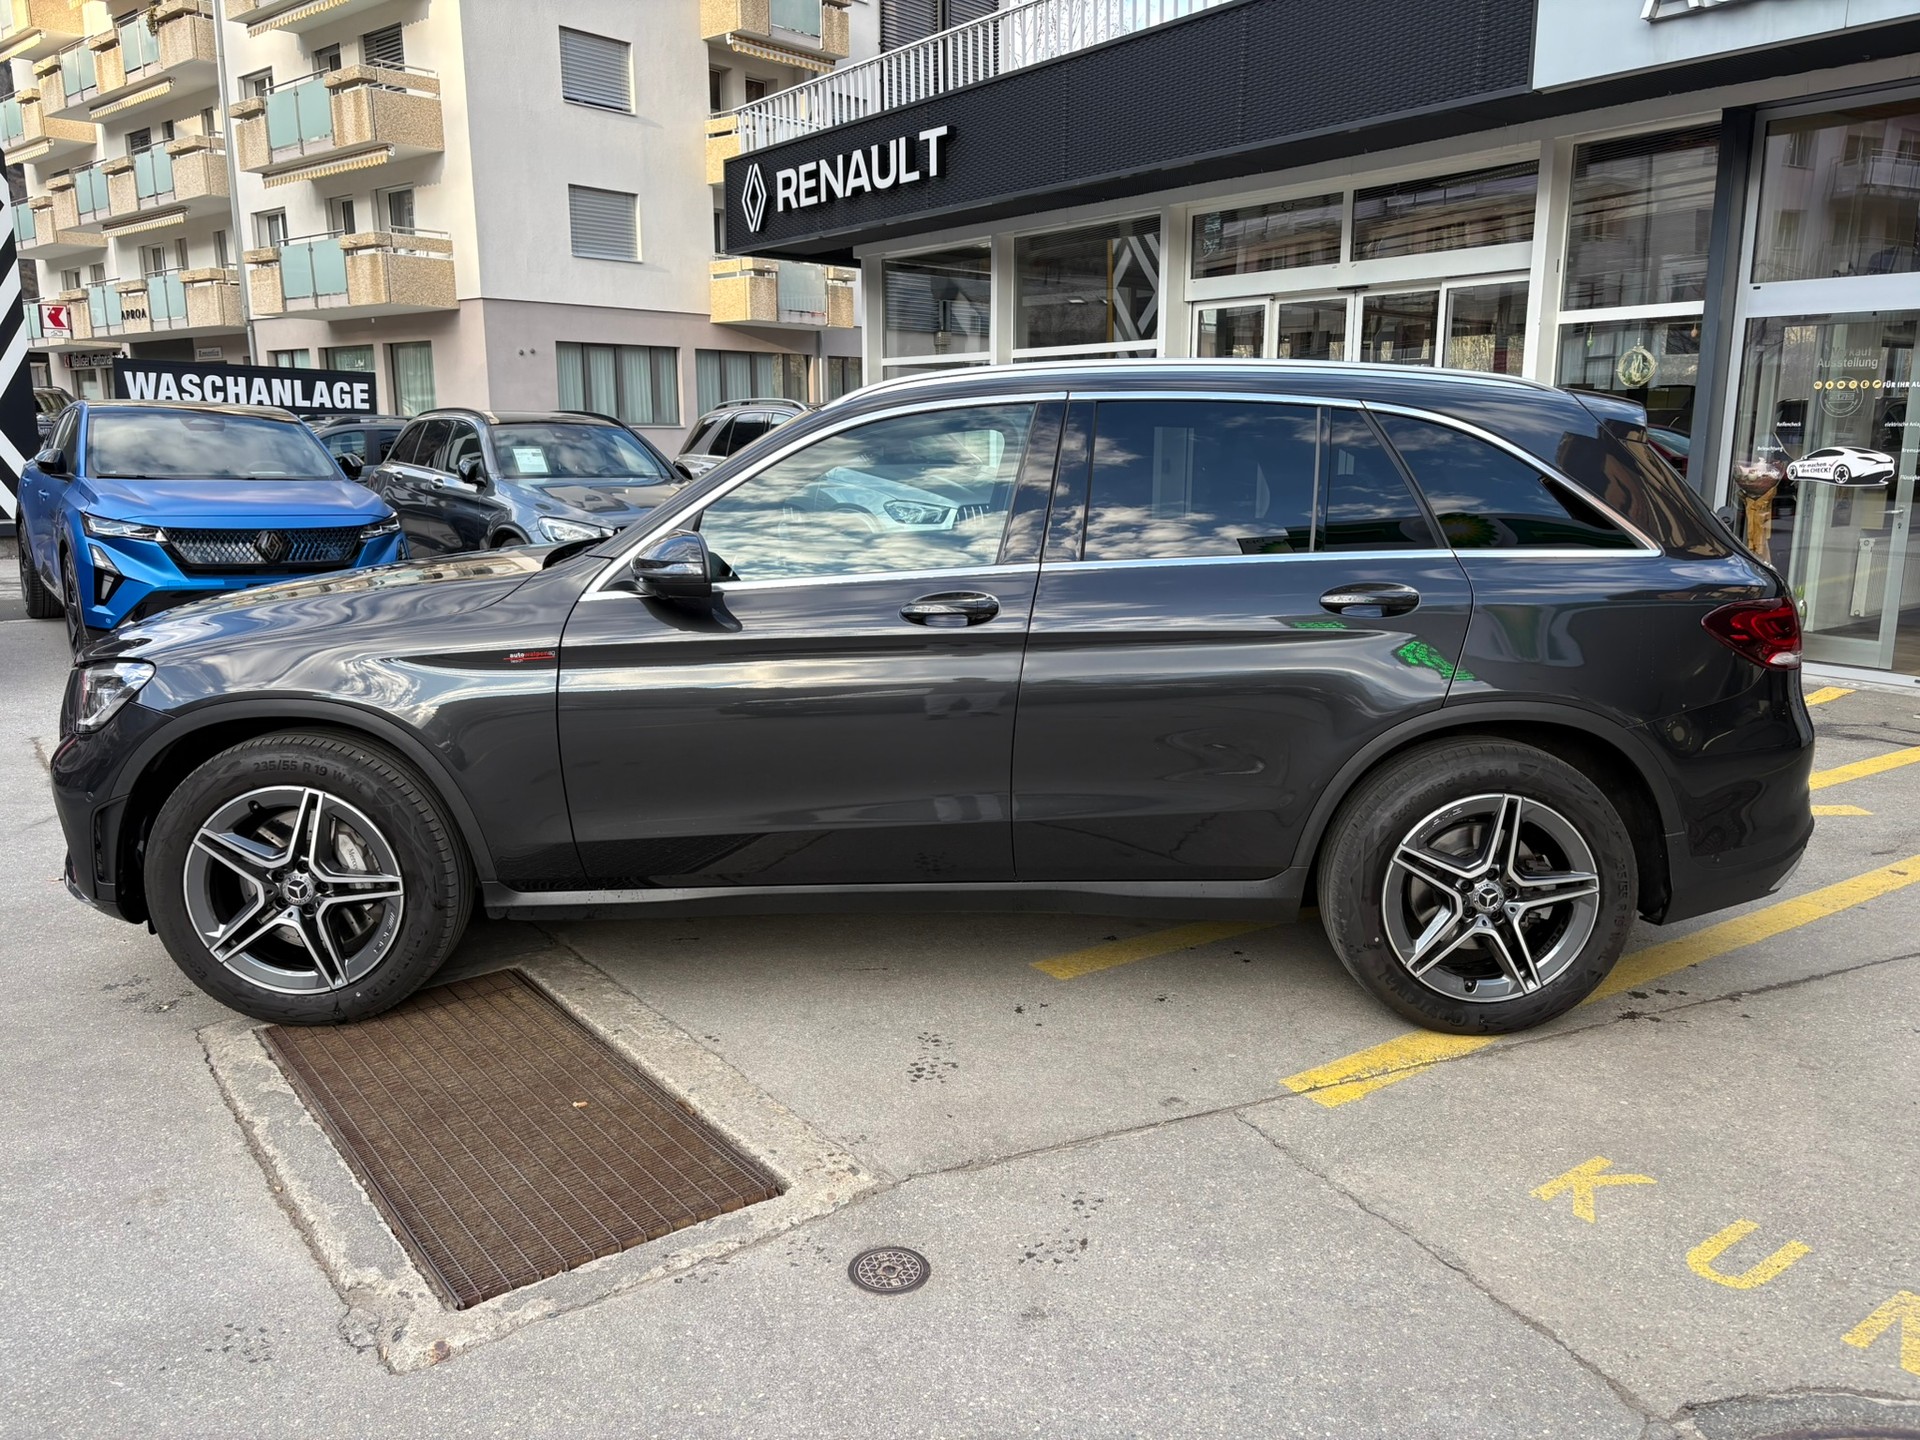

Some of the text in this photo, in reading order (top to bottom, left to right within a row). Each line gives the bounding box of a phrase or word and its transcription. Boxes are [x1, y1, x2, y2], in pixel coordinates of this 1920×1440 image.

[776, 125, 948, 213] RENAULT
[1817, 358, 1878, 369] Ausstellung
[124, 371, 370, 409] WASCHANLAGE
[253, 760, 298, 772] 235/55
[302, 762, 311, 772] R
[314, 765, 328, 776] 19
